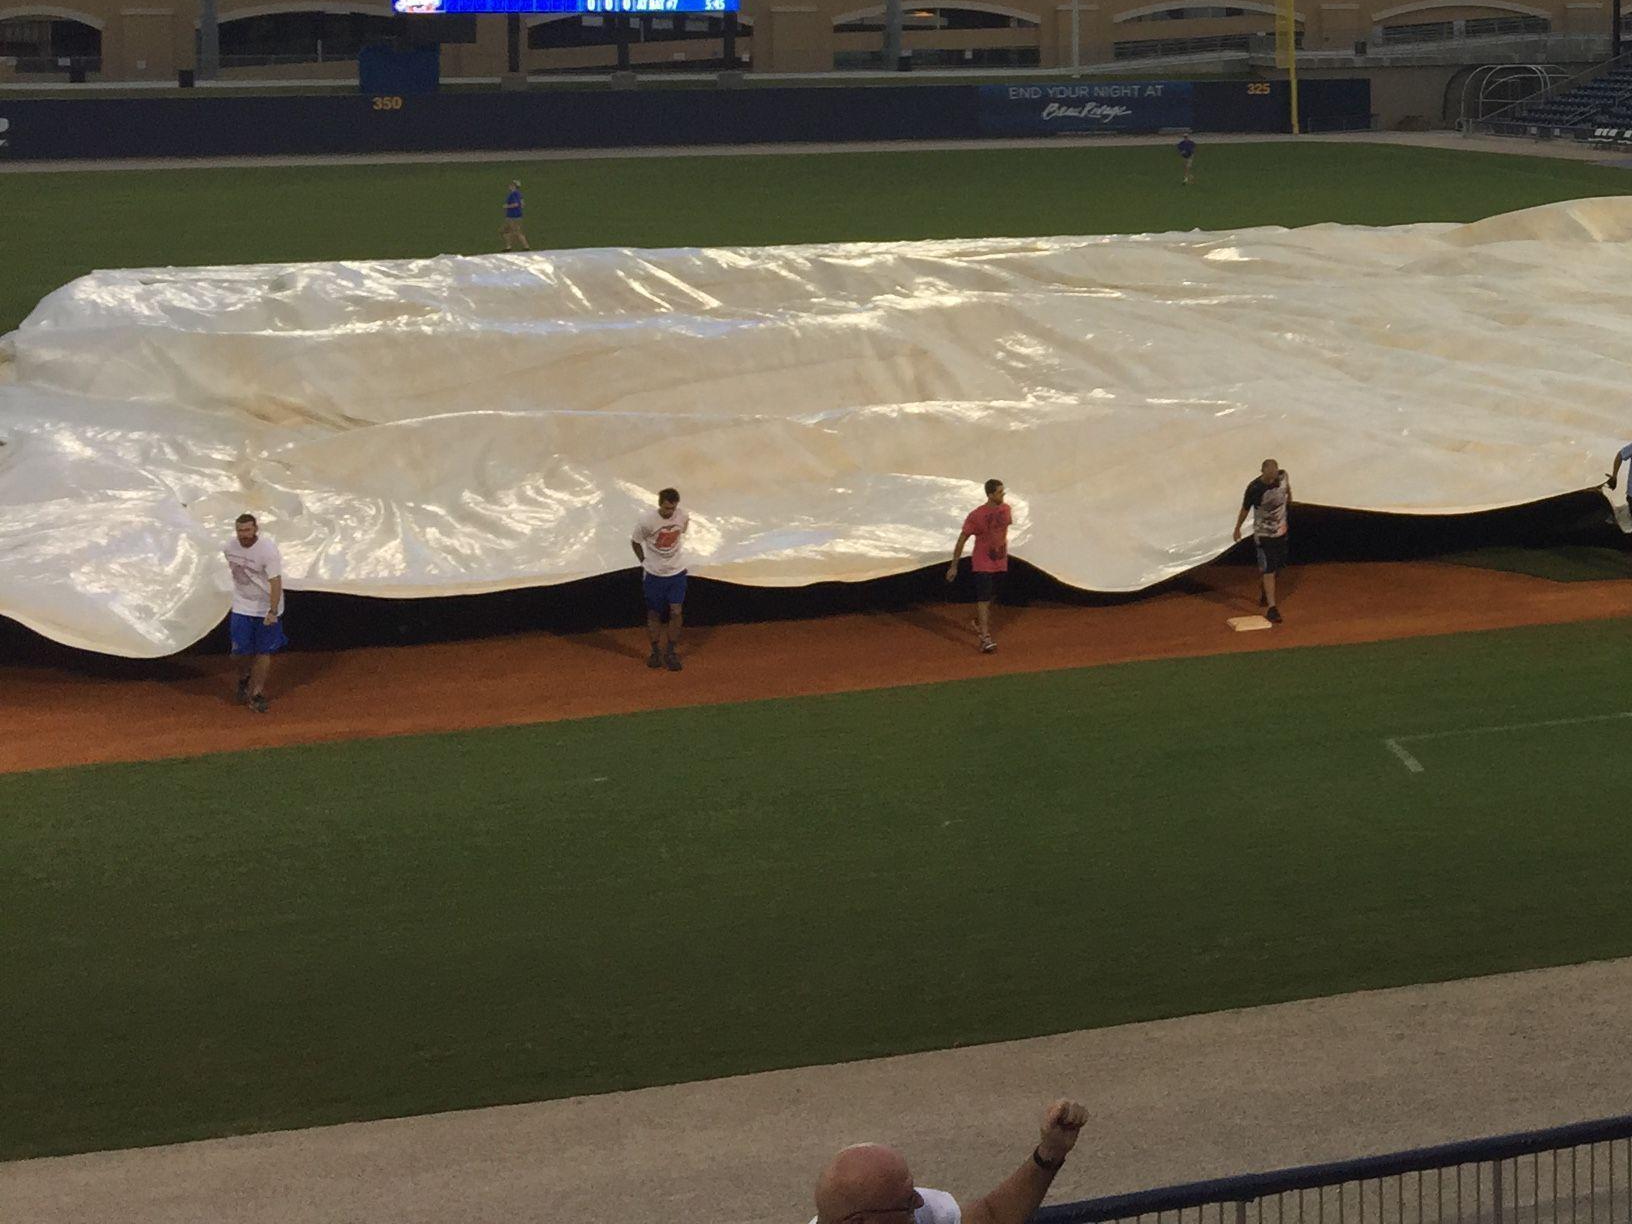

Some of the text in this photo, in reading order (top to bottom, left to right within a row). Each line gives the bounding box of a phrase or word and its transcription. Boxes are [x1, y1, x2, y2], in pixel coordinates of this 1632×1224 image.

[1009, 85, 1164, 100] END YOUR NIGHT AT
[1247, 82, 1271, 95] 325
[372, 96, 402, 110] 350
